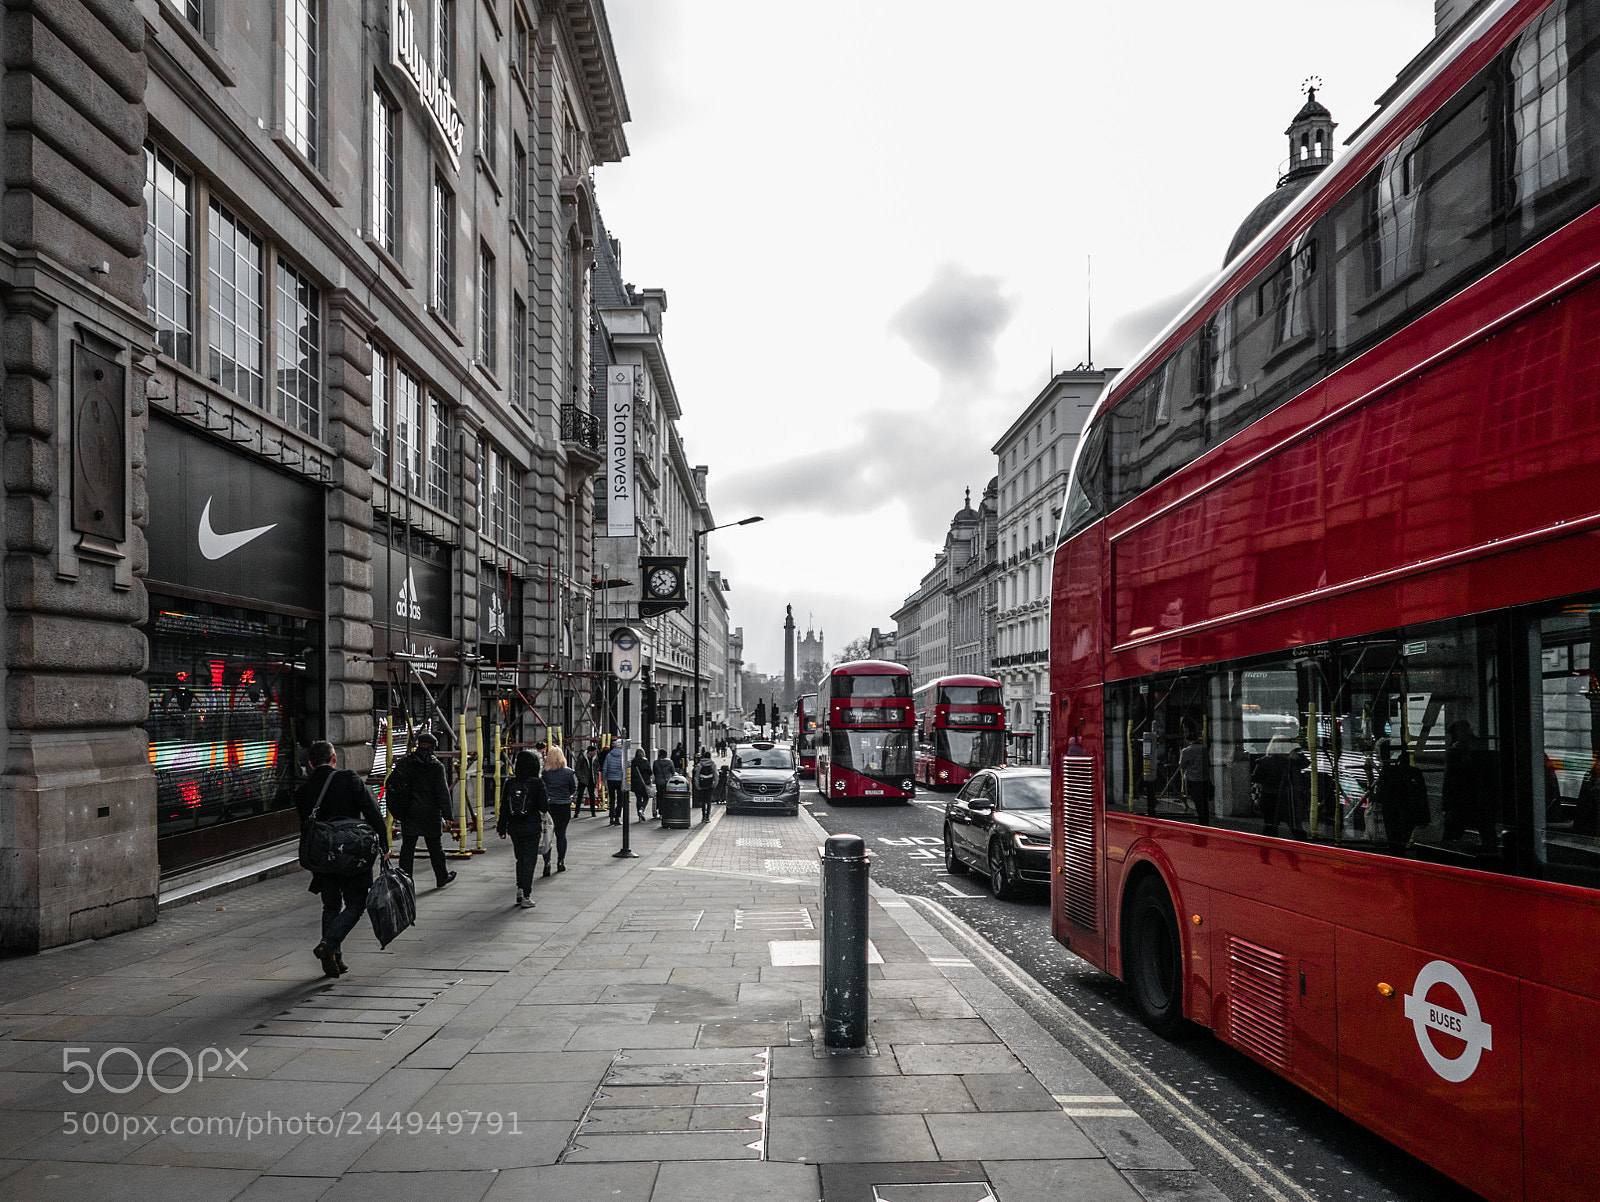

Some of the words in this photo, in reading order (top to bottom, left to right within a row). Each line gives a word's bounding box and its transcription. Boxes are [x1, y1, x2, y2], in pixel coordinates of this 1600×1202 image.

[614, 403, 631, 500] Stonewest
[396, 599, 421, 620] addas
[890, 710, 898, 720] 3
[984, 715, 992, 723] 12
[1430, 1009, 1462, 1032] BUSES
